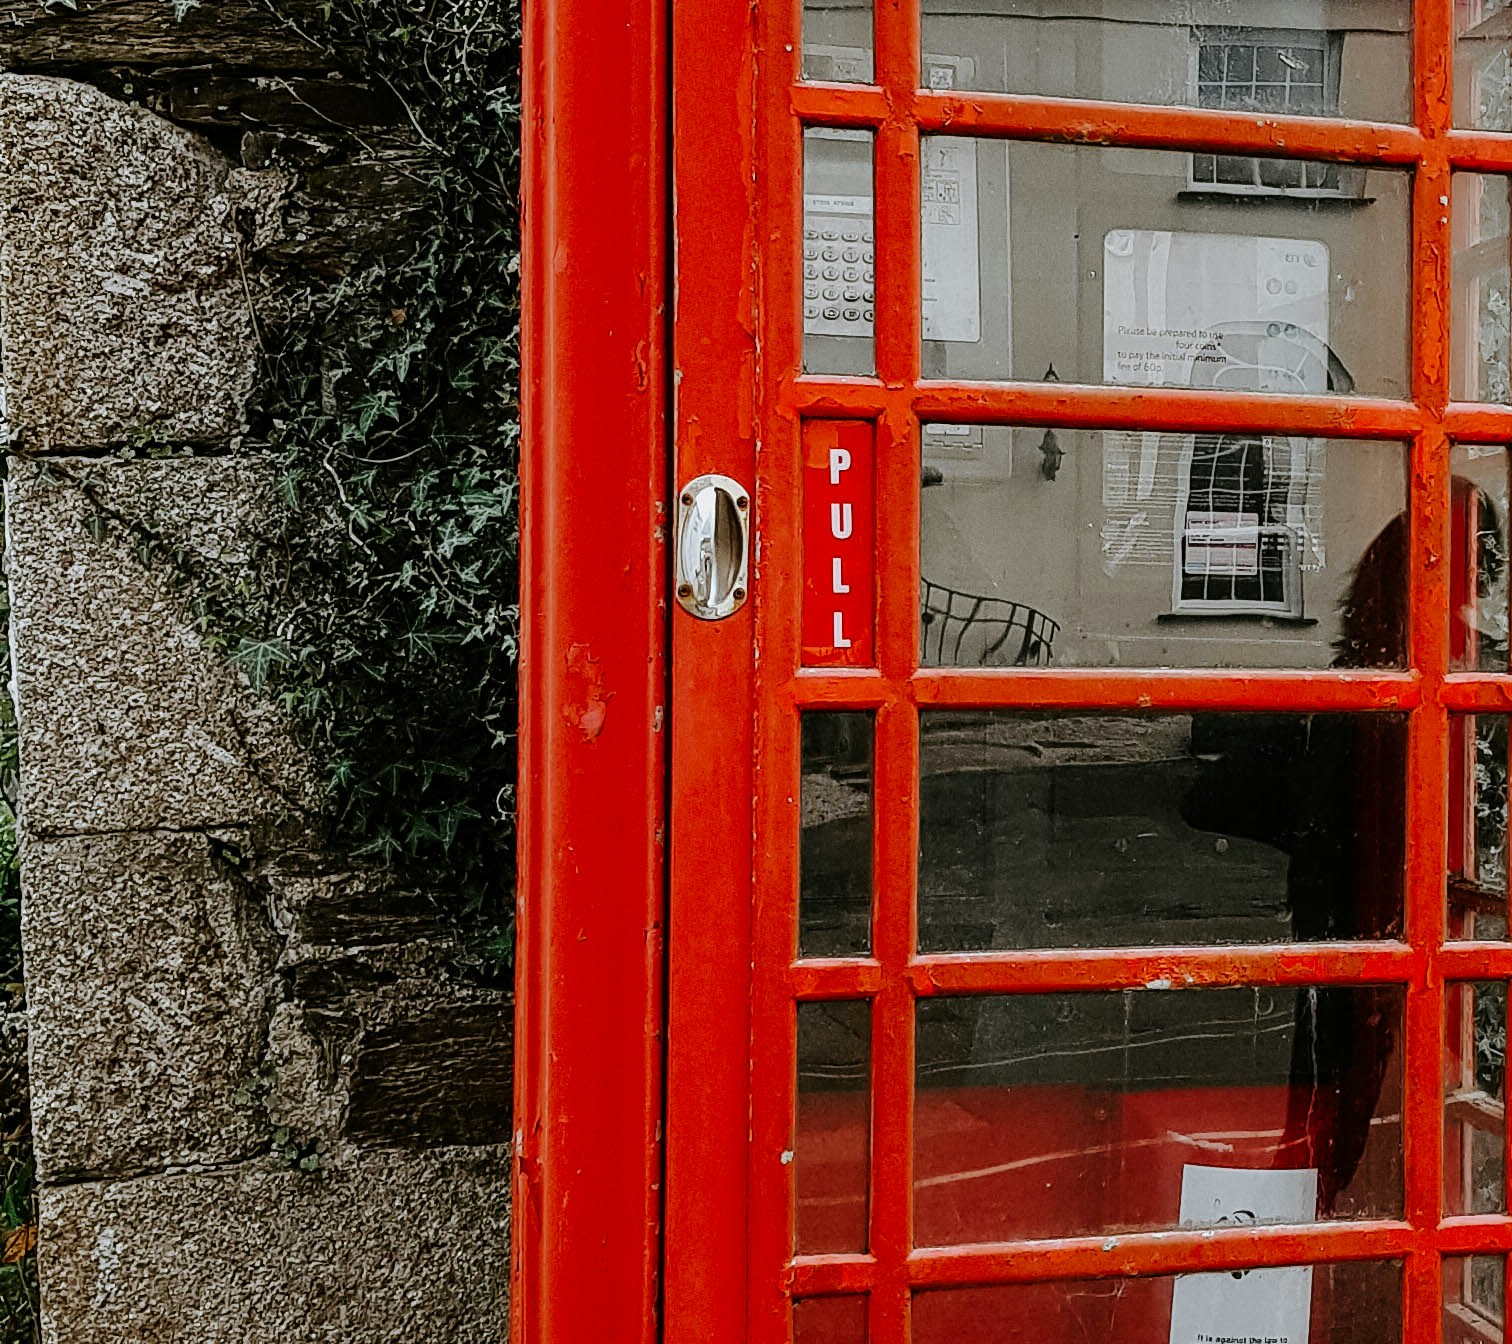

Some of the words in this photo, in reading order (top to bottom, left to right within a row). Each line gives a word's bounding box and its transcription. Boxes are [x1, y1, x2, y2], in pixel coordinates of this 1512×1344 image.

[1118, 326, 1144, 336] Please
[1146, 327, 1157, 336] be
[1159, 329, 1197, 340] prepared
[1199, 330, 1208, 338] to
[1176, 341, 1192, 350] four
[1117, 351, 1127, 359] to
[1128, 352, 1144, 362] pay
[1146, 351, 1160, 360] the
[1161, 352, 1186, 361] initial
[1187, 355, 1227, 364] minimum
[1133, 362, 1141, 371] of
[829, 448, 853, 648] PULL
[1205, 1334, 1213, 1342] is
